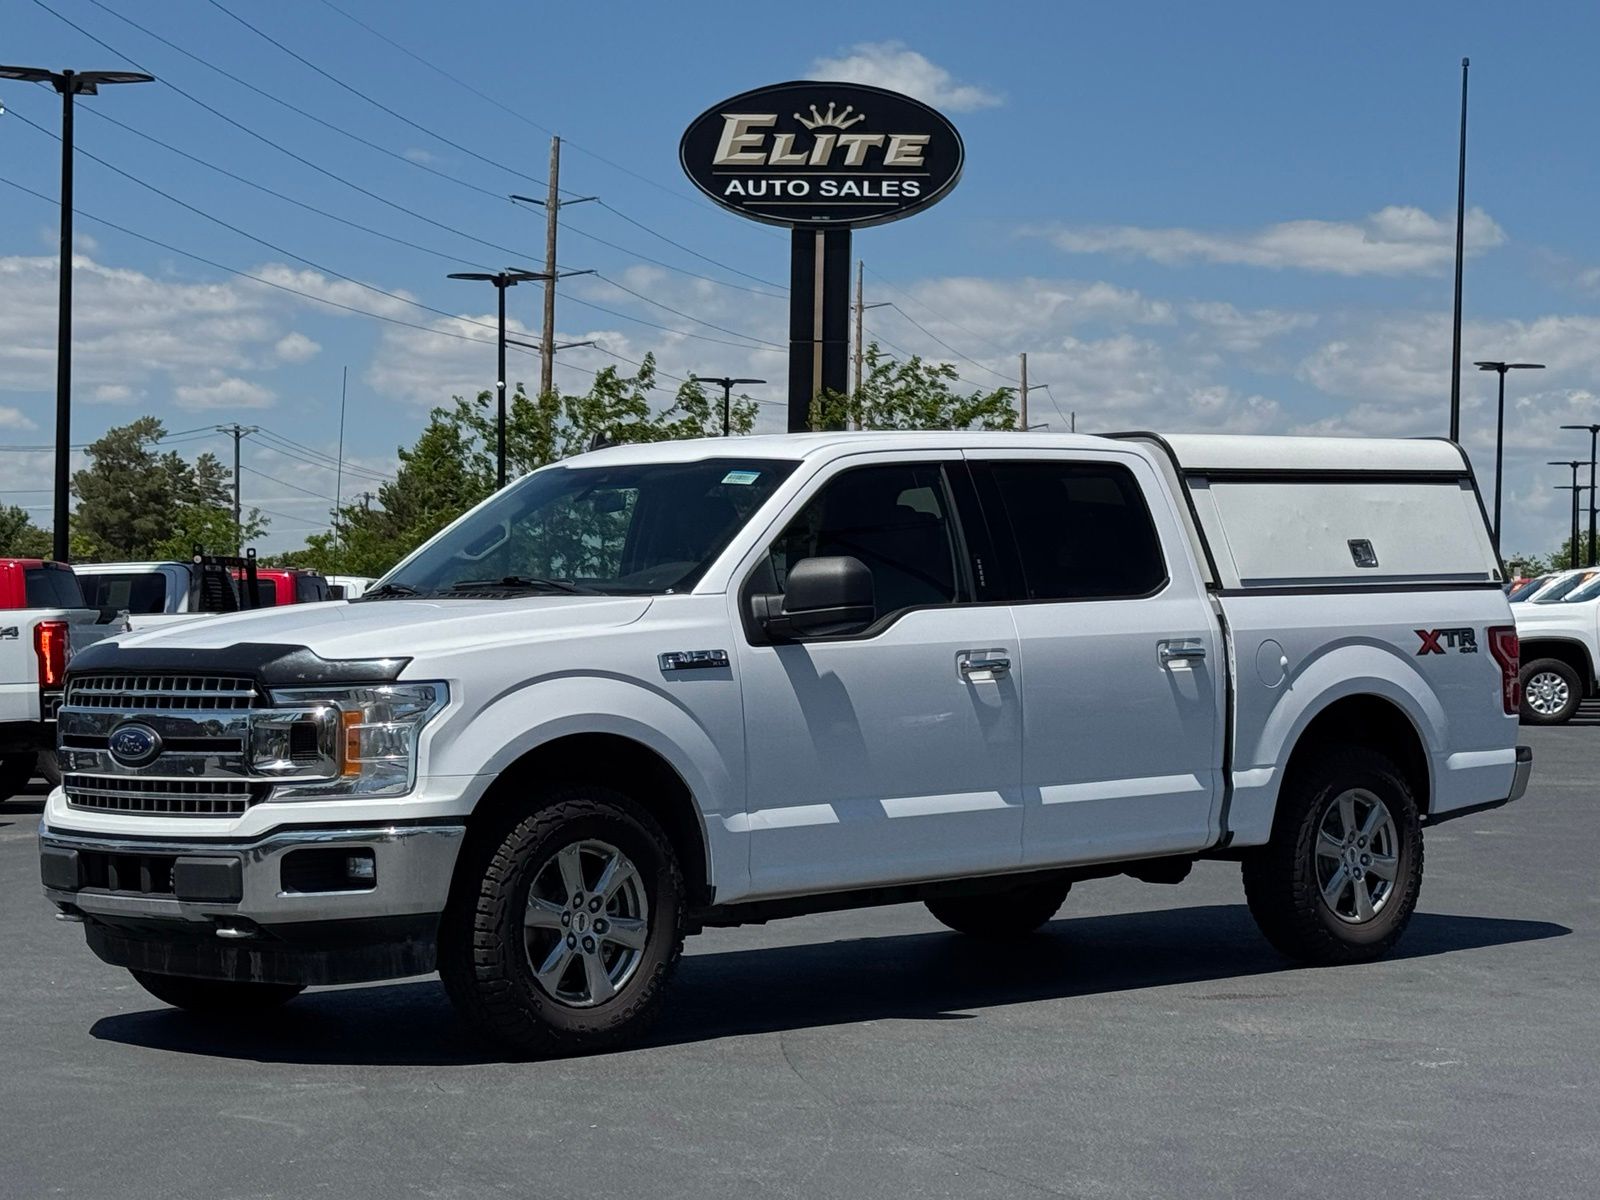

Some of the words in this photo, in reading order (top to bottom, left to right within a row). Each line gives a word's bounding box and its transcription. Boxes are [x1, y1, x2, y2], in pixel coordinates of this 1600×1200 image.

[724, 179, 810, 197] AUTO
[819, 179, 921, 198] SALES
[1413, 627, 1478, 656] XTR
[117, 733, 143, 752] Ford
